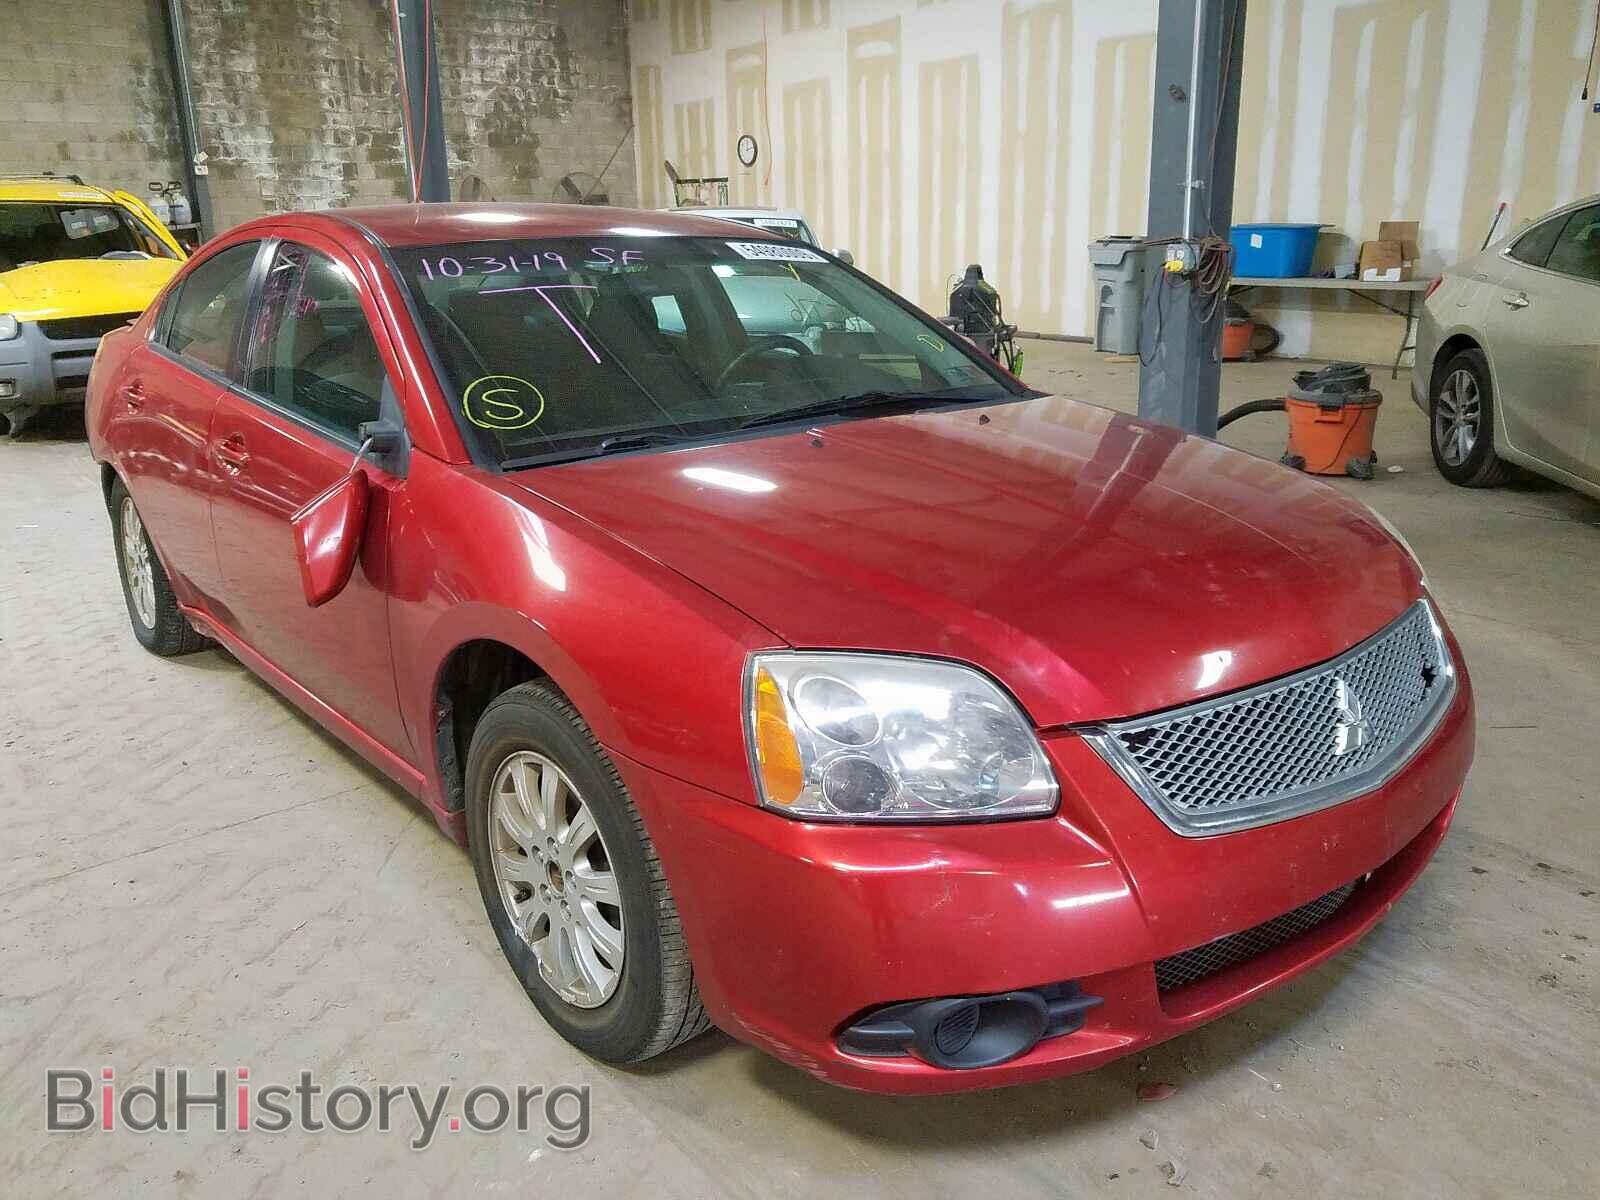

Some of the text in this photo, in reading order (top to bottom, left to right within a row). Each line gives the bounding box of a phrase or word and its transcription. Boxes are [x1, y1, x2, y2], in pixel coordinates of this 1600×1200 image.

[420, 251, 568, 281] 10-31-19
[584, 247, 645, 266] SF
[478, 284, 602, 365] T
[481, 388, 524, 420] S
